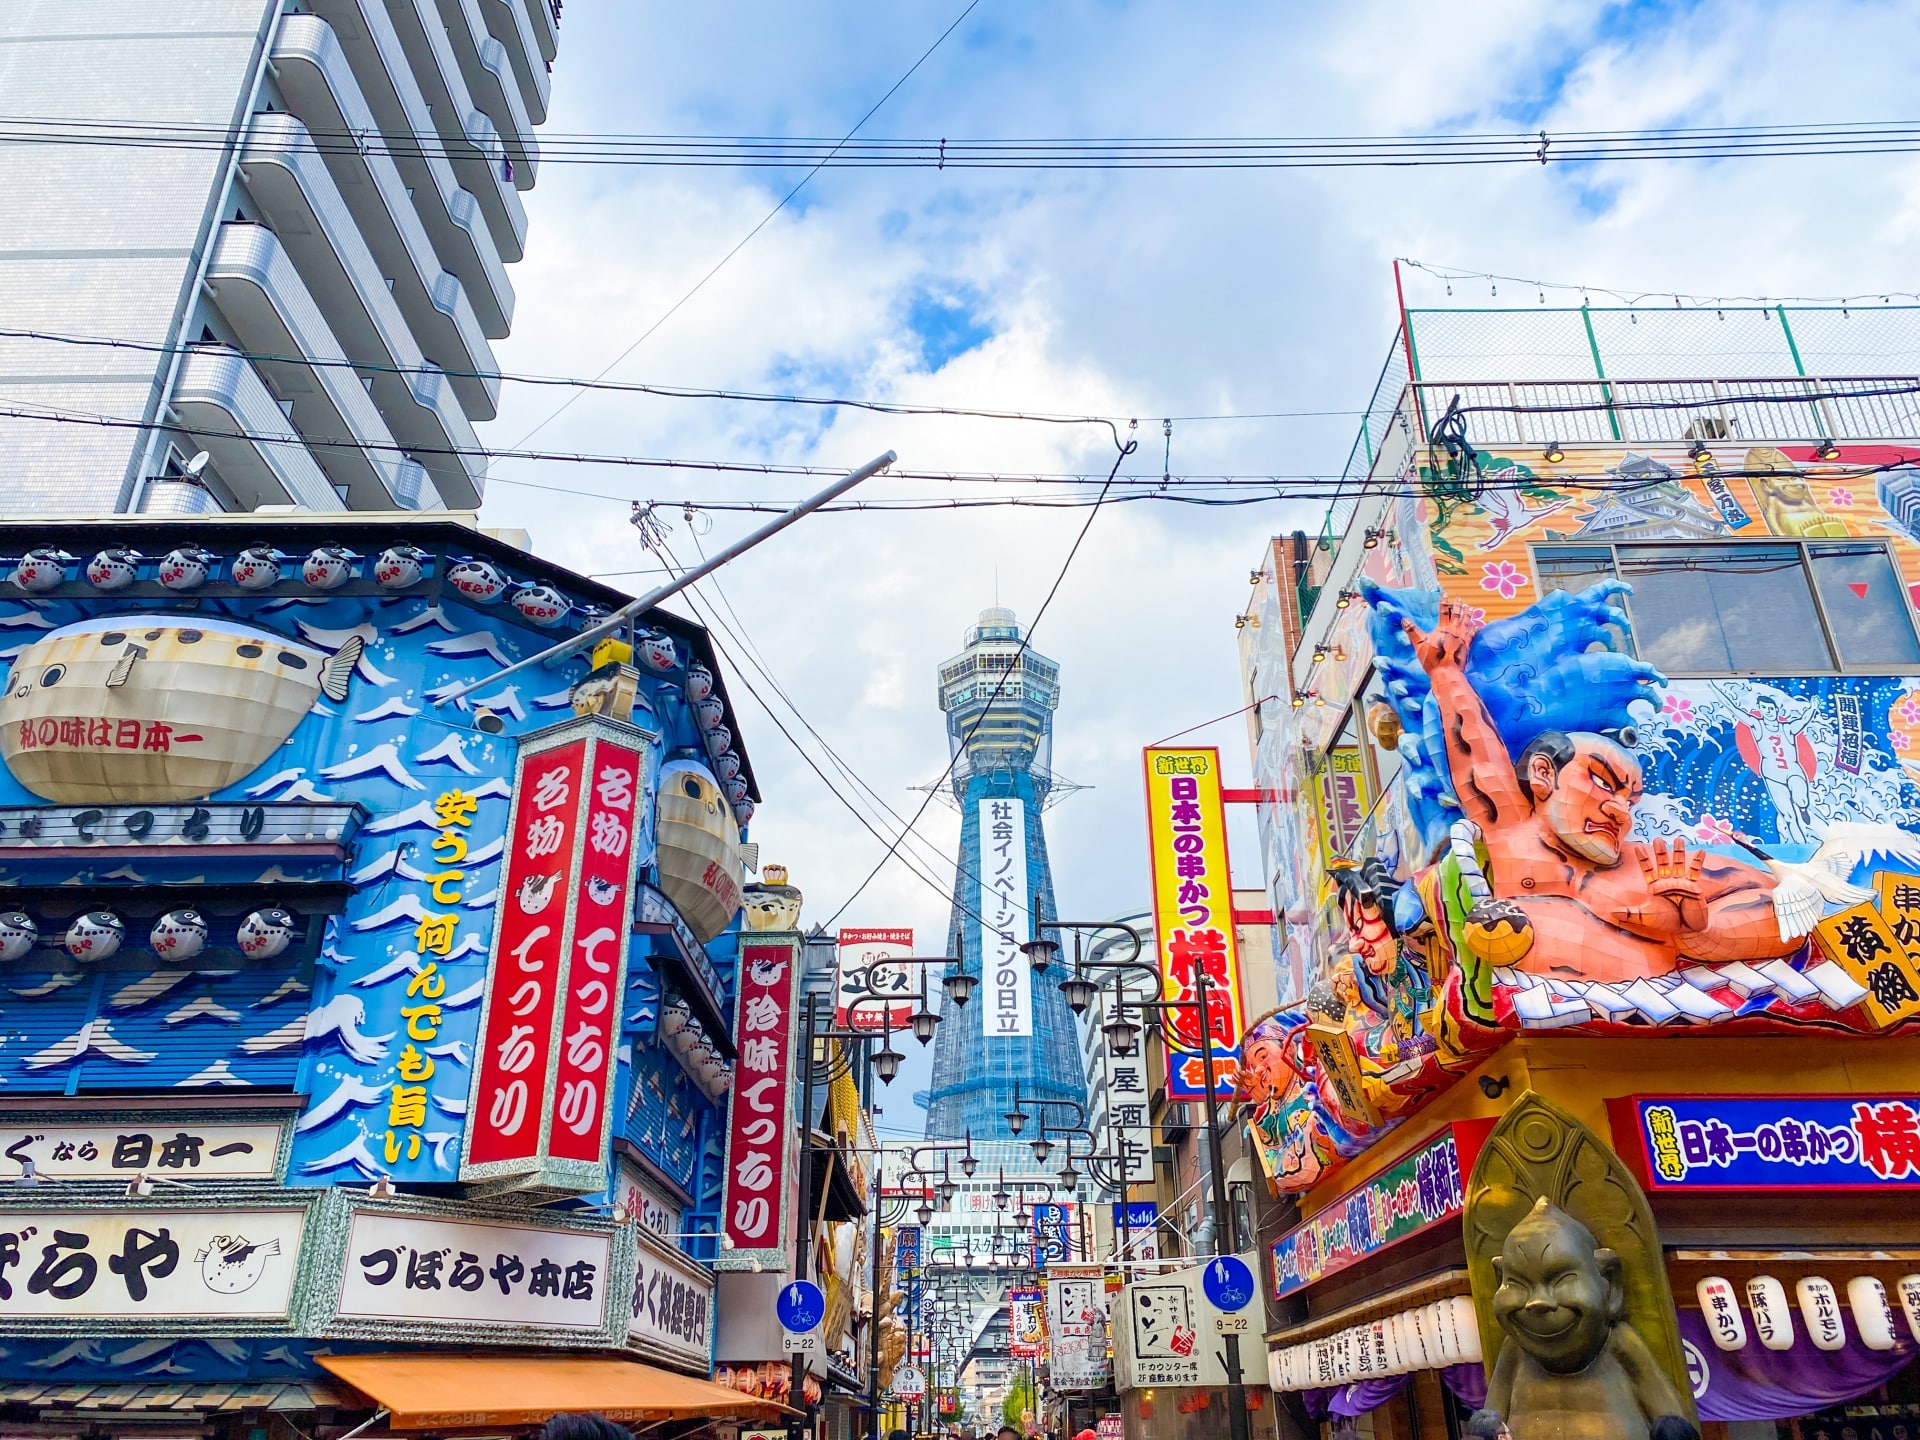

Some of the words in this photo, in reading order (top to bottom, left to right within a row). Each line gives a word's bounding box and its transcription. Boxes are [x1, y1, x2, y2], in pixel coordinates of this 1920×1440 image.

[19, 716, 204, 752] 私の味は日本一
[1157, 756, 1208, 774] 新世界
[1171, 777, 1210, 926] 日本一の串かつ
[991, 801, 1020, 1033] 社会イノベーションの日立
[1650, 1110, 1683, 1178] 新世界
[1680, 1121, 1856, 1164] 日本一の串かつ
[360, 1244, 598, 1301] づぼらや本店
[1711, 1296, 1738, 1342] 串かつ
[1814, 1293, 1838, 1342] ホルモン
[1148, 1362, 1198, 1371] カウンター席
